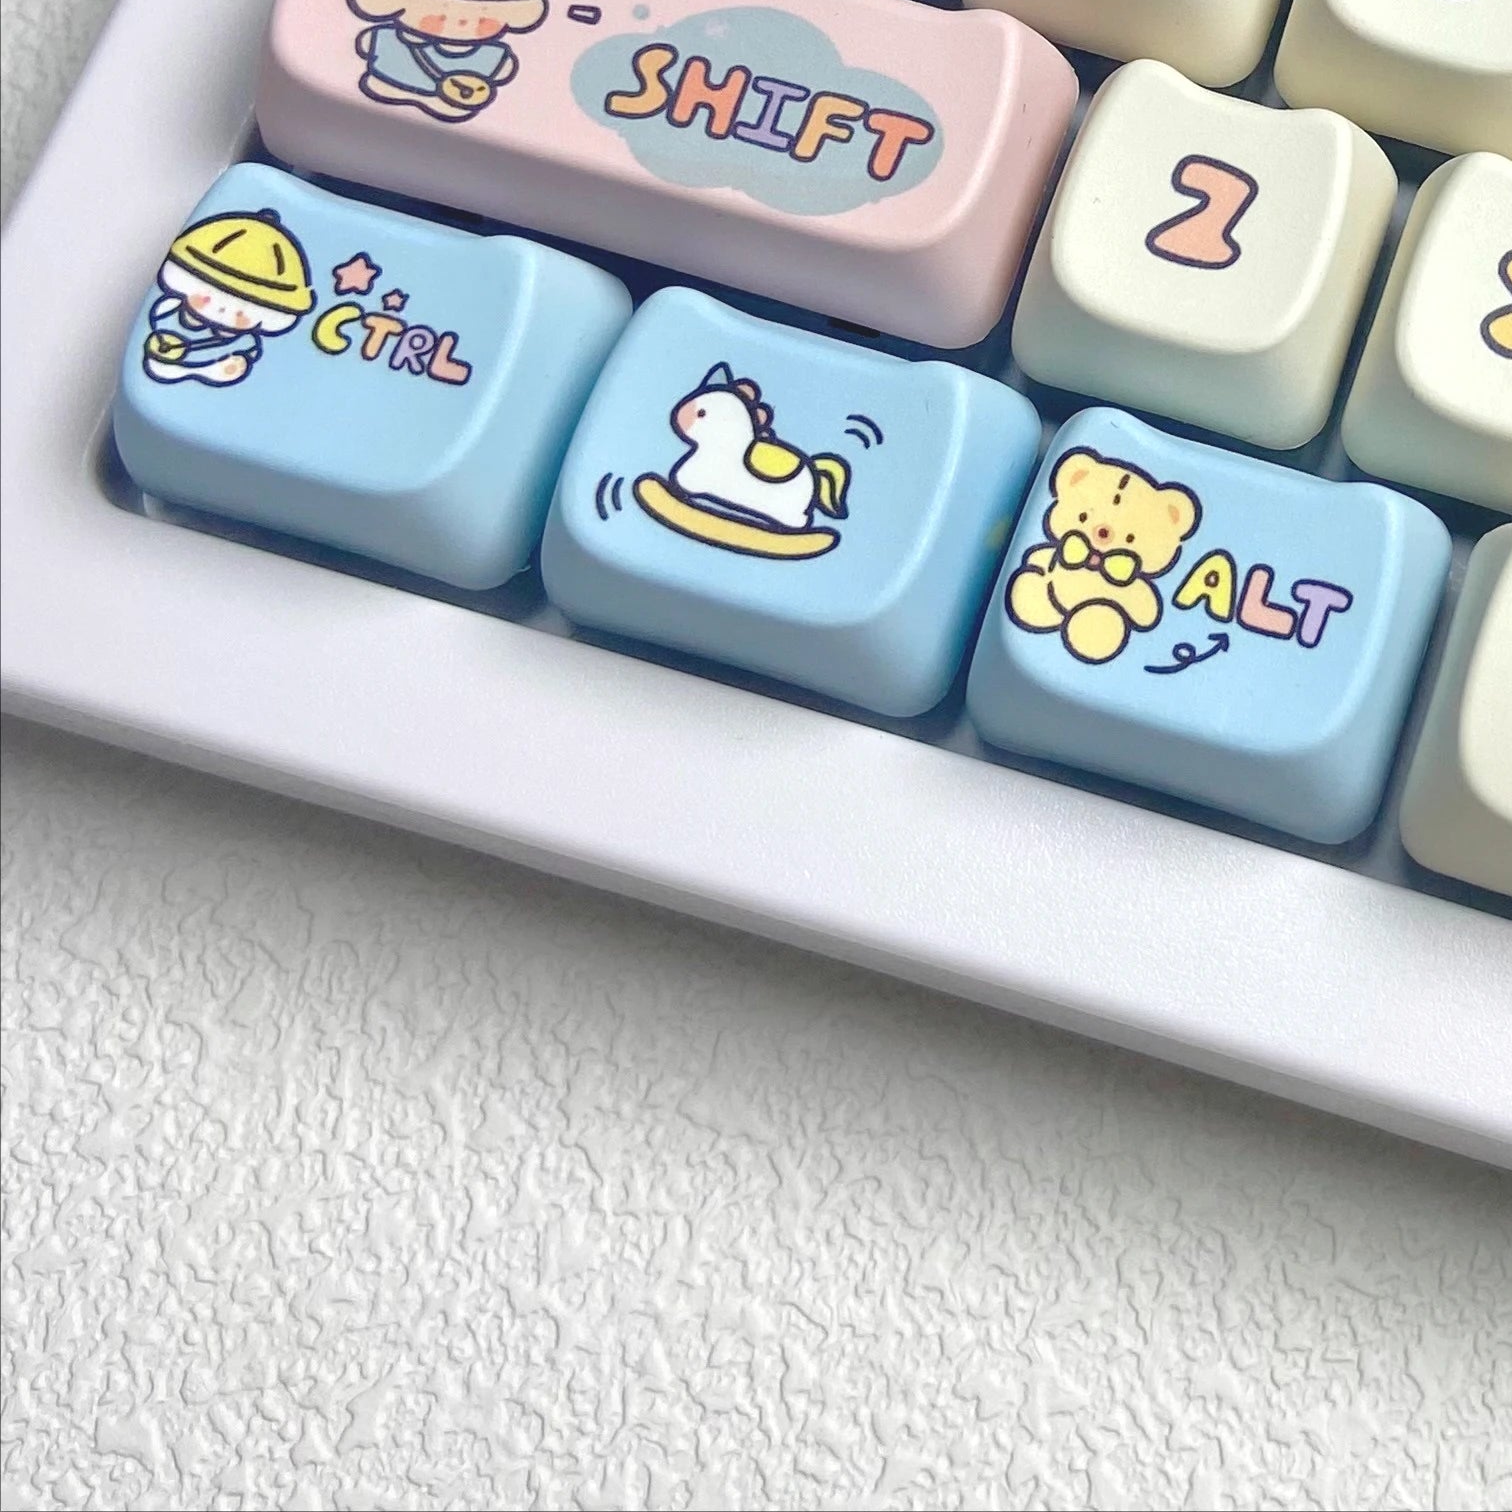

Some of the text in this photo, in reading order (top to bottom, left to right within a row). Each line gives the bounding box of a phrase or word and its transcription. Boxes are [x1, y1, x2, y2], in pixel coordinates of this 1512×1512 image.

[605, 43, 935, 182] SHIFT
[1145, 155, 1258, 270] Z
[314, 302, 473, 386] CTRL
[1172, 548, 1353, 648] ALT
